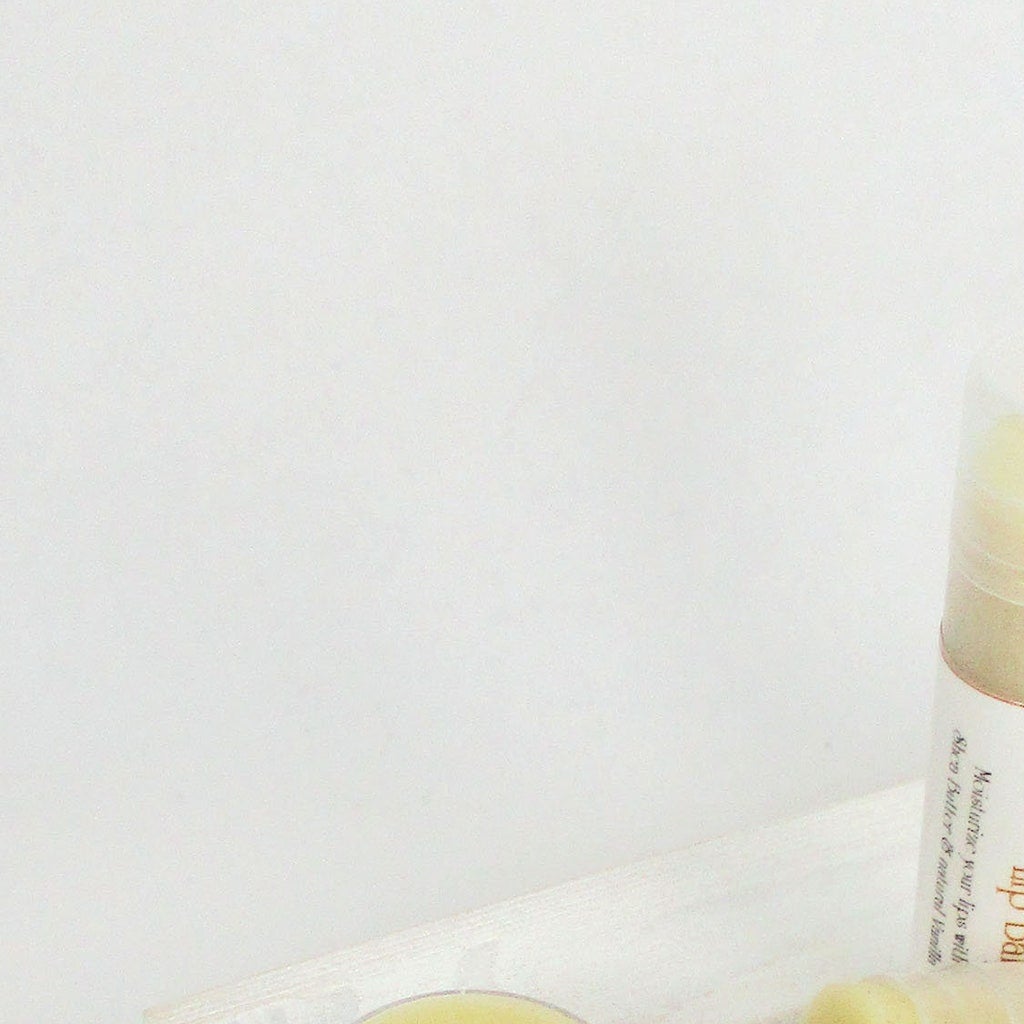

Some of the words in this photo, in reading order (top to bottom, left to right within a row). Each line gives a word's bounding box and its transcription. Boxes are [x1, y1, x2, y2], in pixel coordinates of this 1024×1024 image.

[957, 852, 975, 897] your
[952, 897, 976, 930] lips
[951, 932, 970, 964] with
